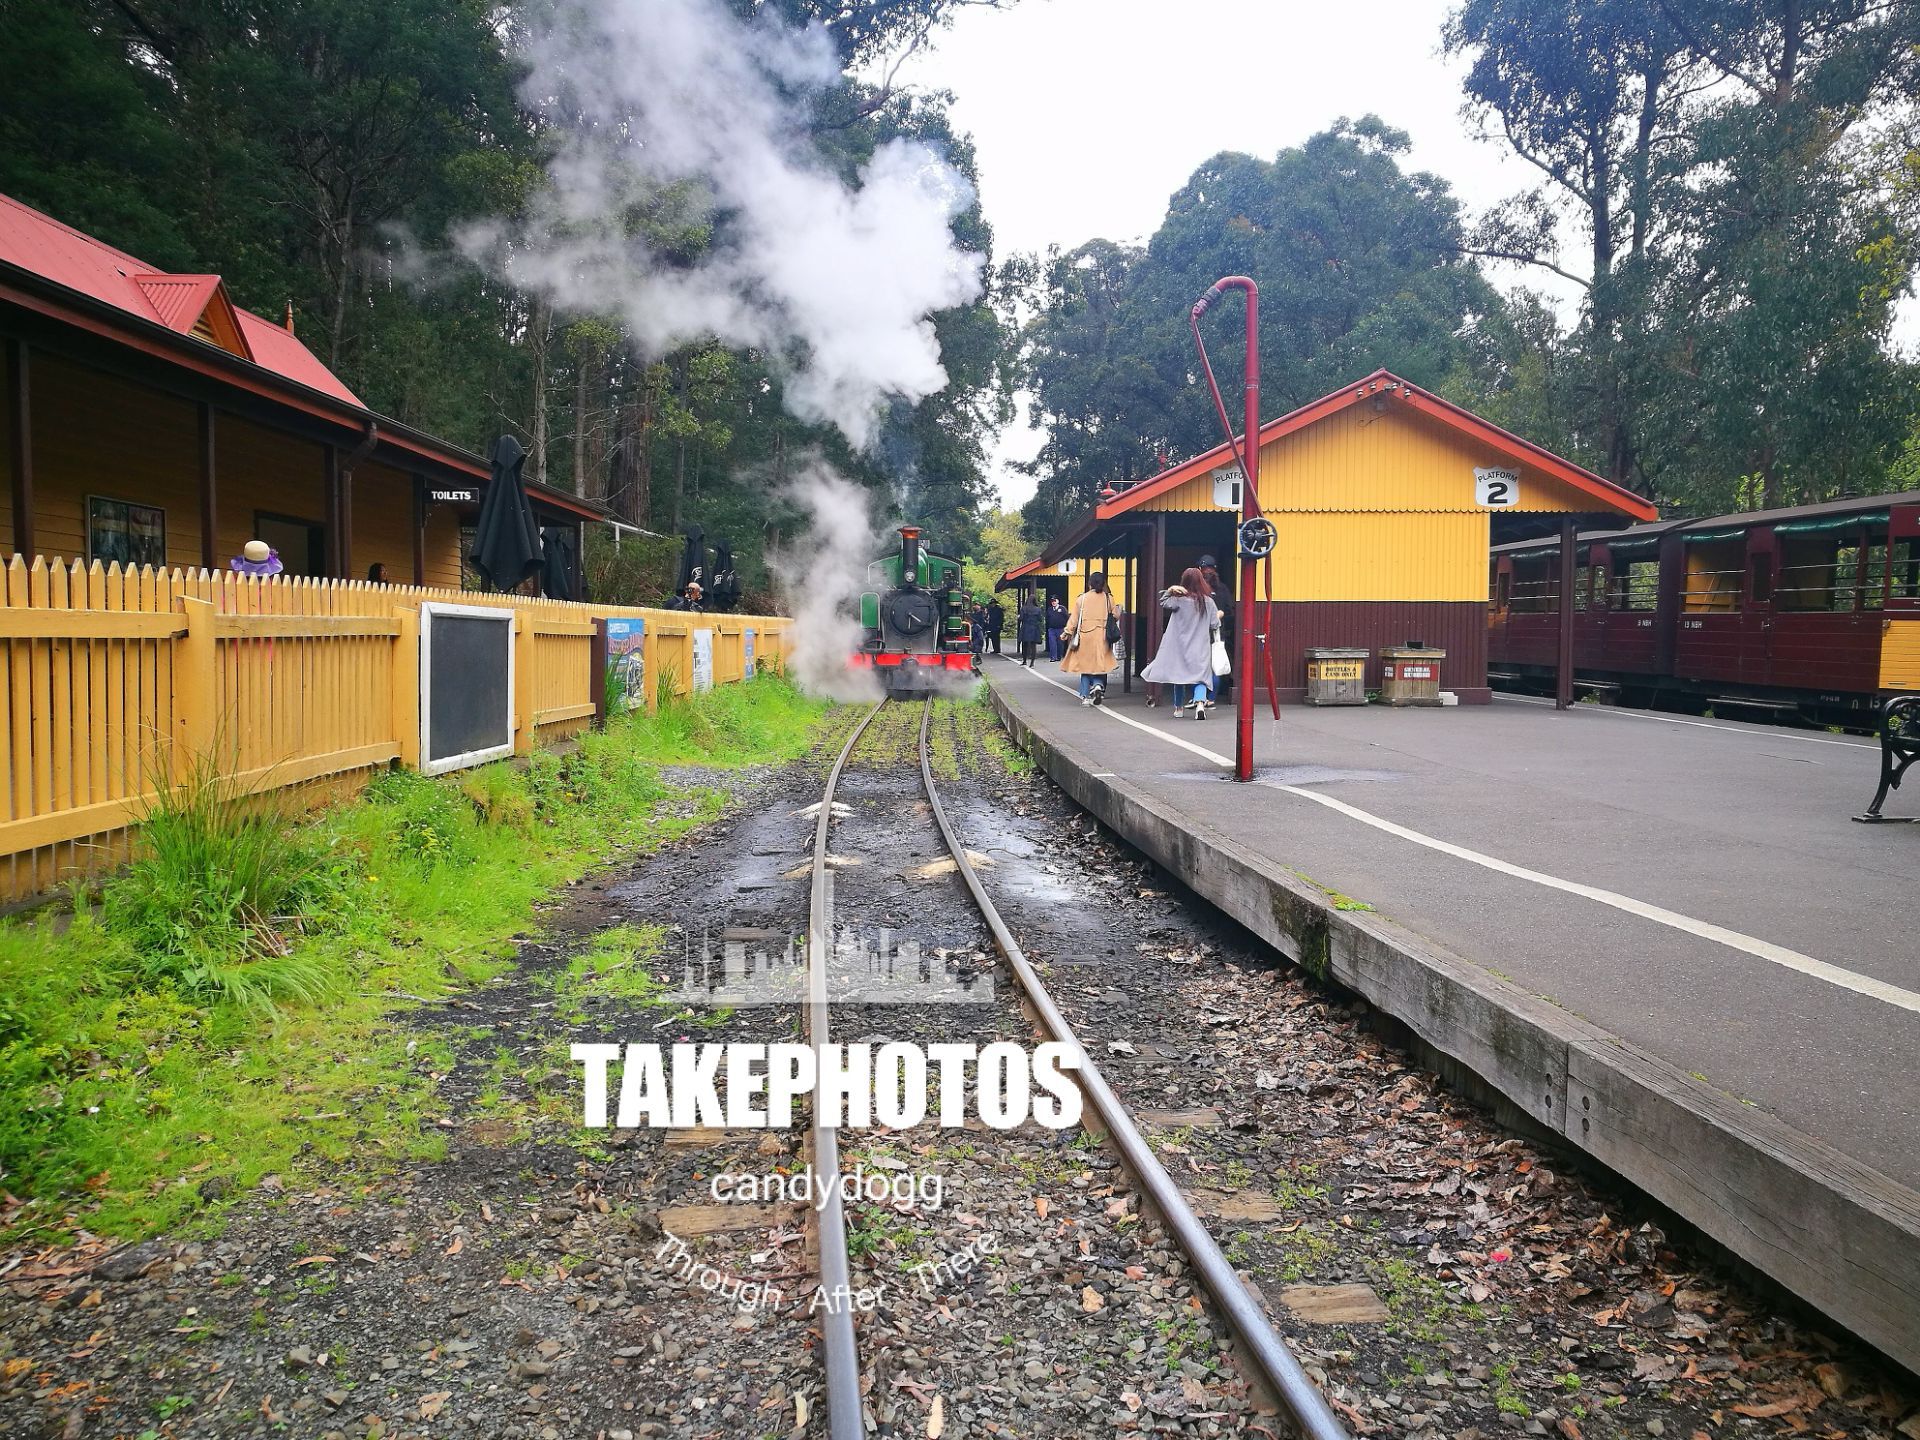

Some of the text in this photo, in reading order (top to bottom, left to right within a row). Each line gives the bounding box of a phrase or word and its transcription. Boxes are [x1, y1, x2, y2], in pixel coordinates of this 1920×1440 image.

[1215, 472, 1244, 484] PLATFO
[1478, 471, 1518, 483] PLATFORM
[431, 491, 471, 500] TOILETS
[1232, 483, 1240, 504] 1
[1488, 482, 1509, 504] 2
